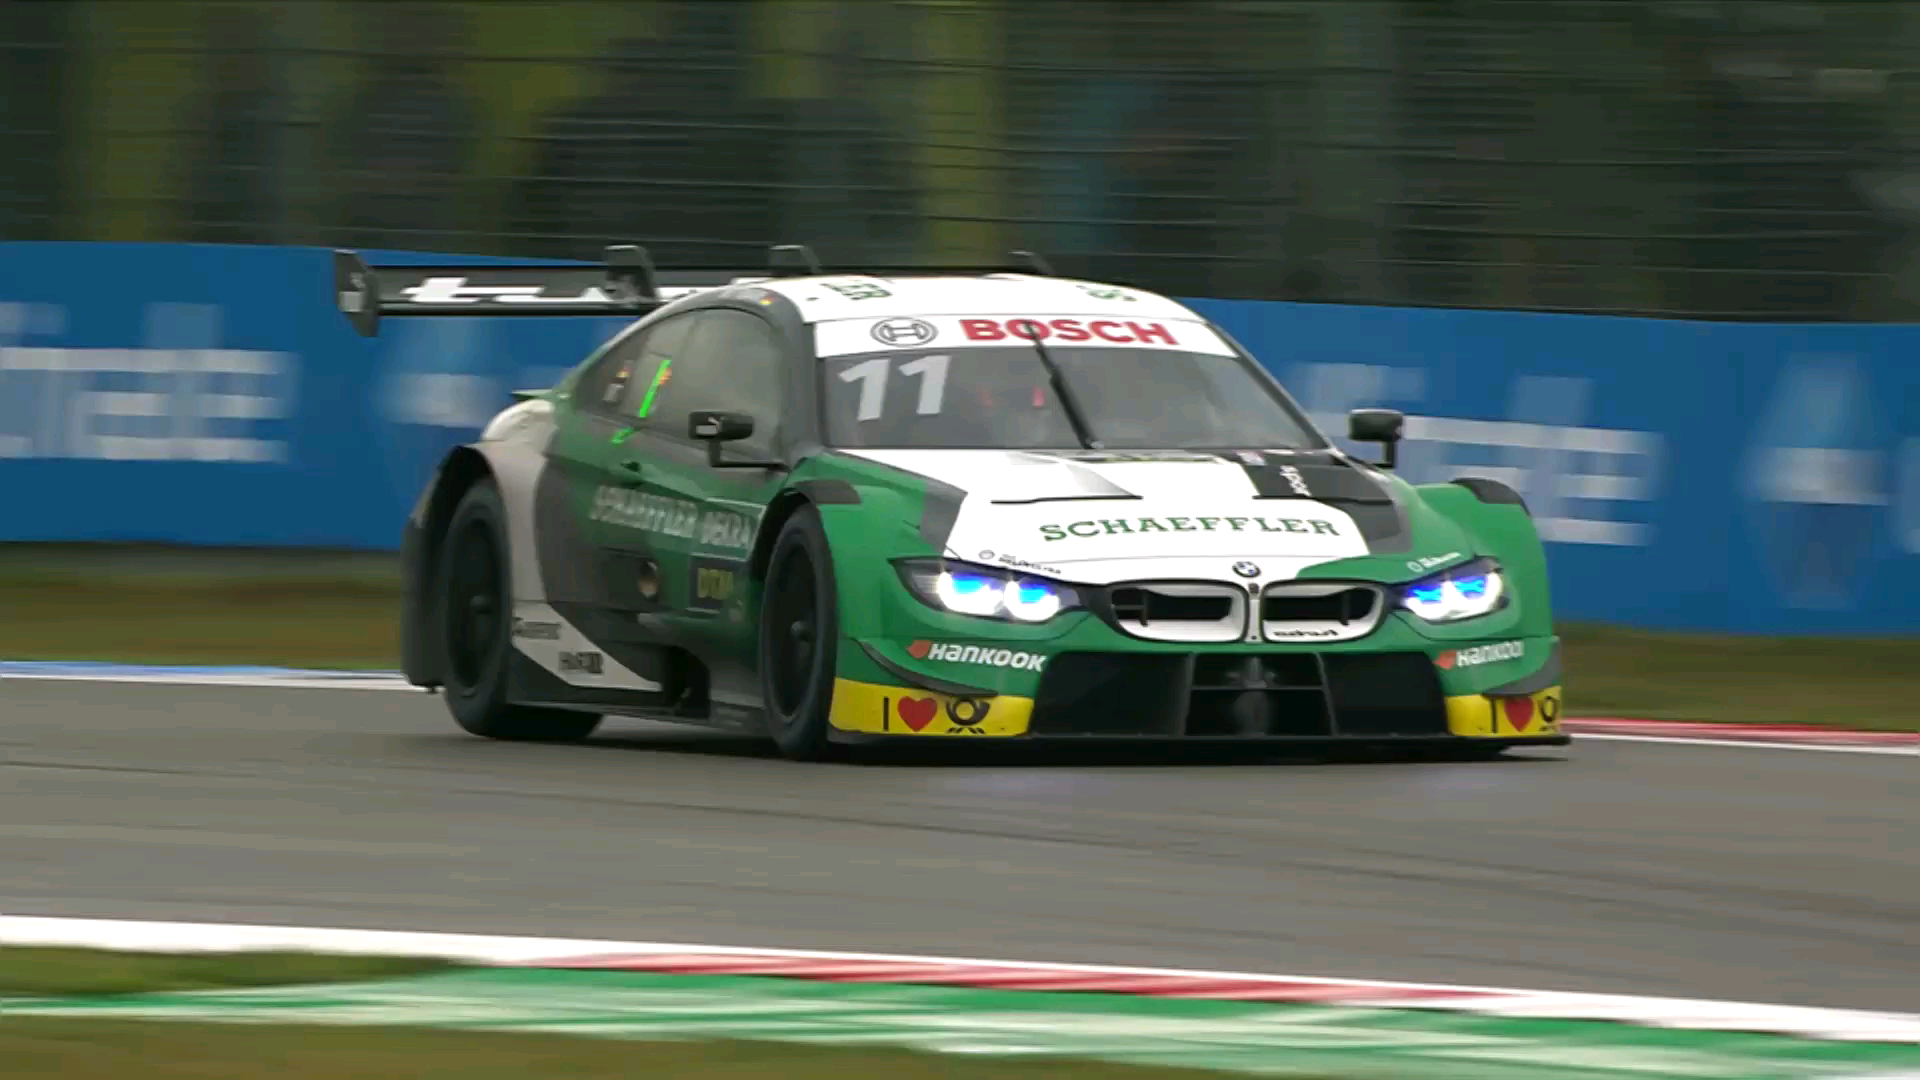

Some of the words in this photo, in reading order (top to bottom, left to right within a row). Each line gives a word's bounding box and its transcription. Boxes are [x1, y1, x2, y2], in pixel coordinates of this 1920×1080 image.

[958, 318, 1180, 346] BOSCH
[838, 355, 951, 422] 11
[1039, 516, 1341, 542] SCHAEFFLER
